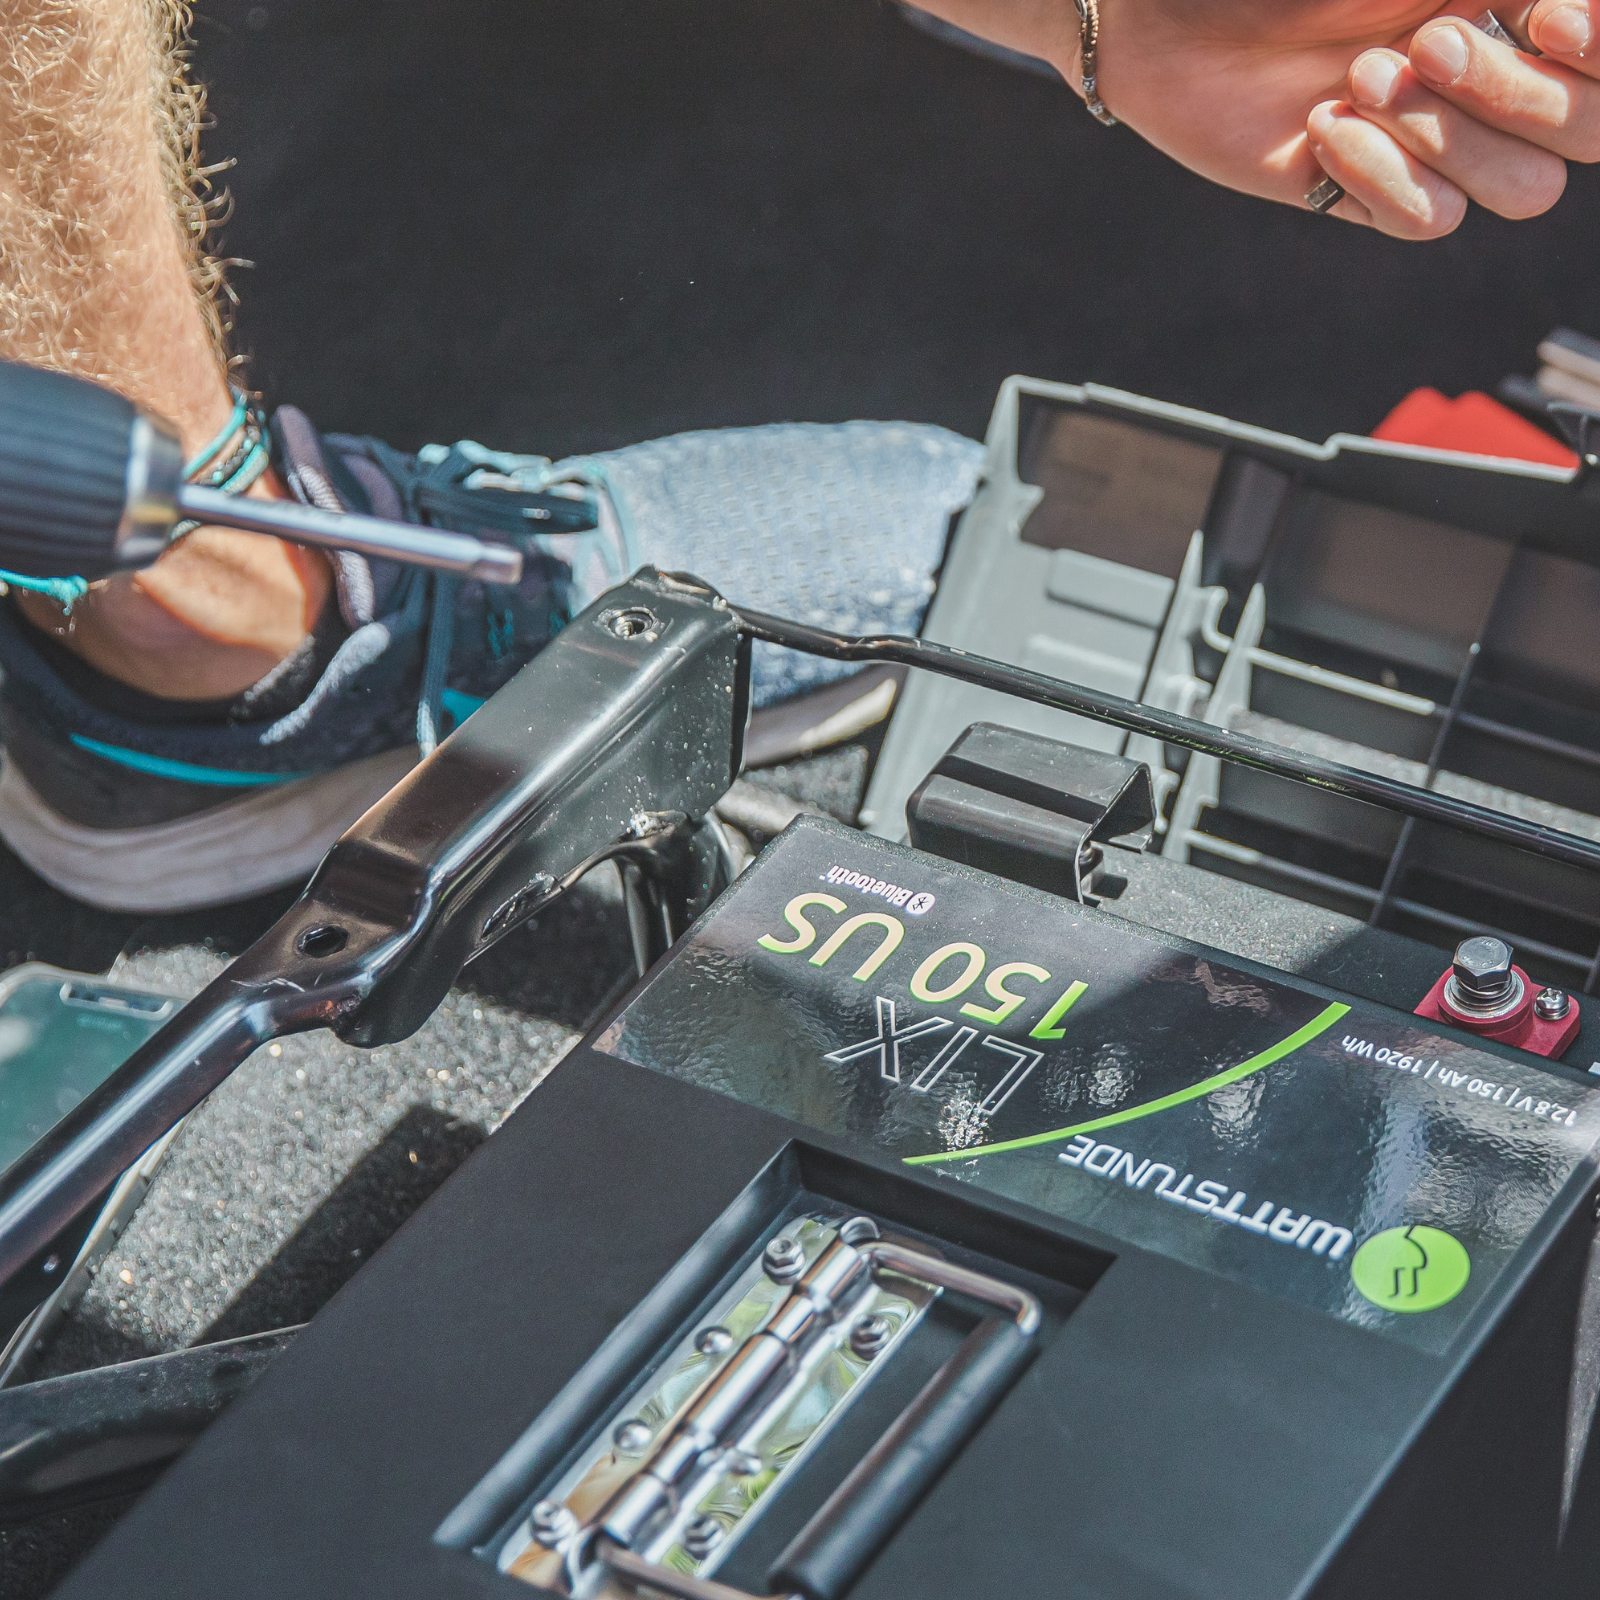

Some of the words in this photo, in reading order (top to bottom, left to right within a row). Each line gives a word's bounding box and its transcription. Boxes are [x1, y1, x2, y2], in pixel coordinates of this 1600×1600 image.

[825, 865, 914, 907] Bluetooth
[756, 892, 905, 982] US
[908, 941, 1089, 1040] 150
[823, 995, 1045, 1117] LIX
[1341, 1034, 1376, 1059] Wh
[1374, 1046, 1423, 1075] 1920
[1436, 1066, 1469, 1089] Ah
[1466, 1078, 1506, 1101] 150
[1057, 1134, 1354, 1261] WATTSTUNDE
